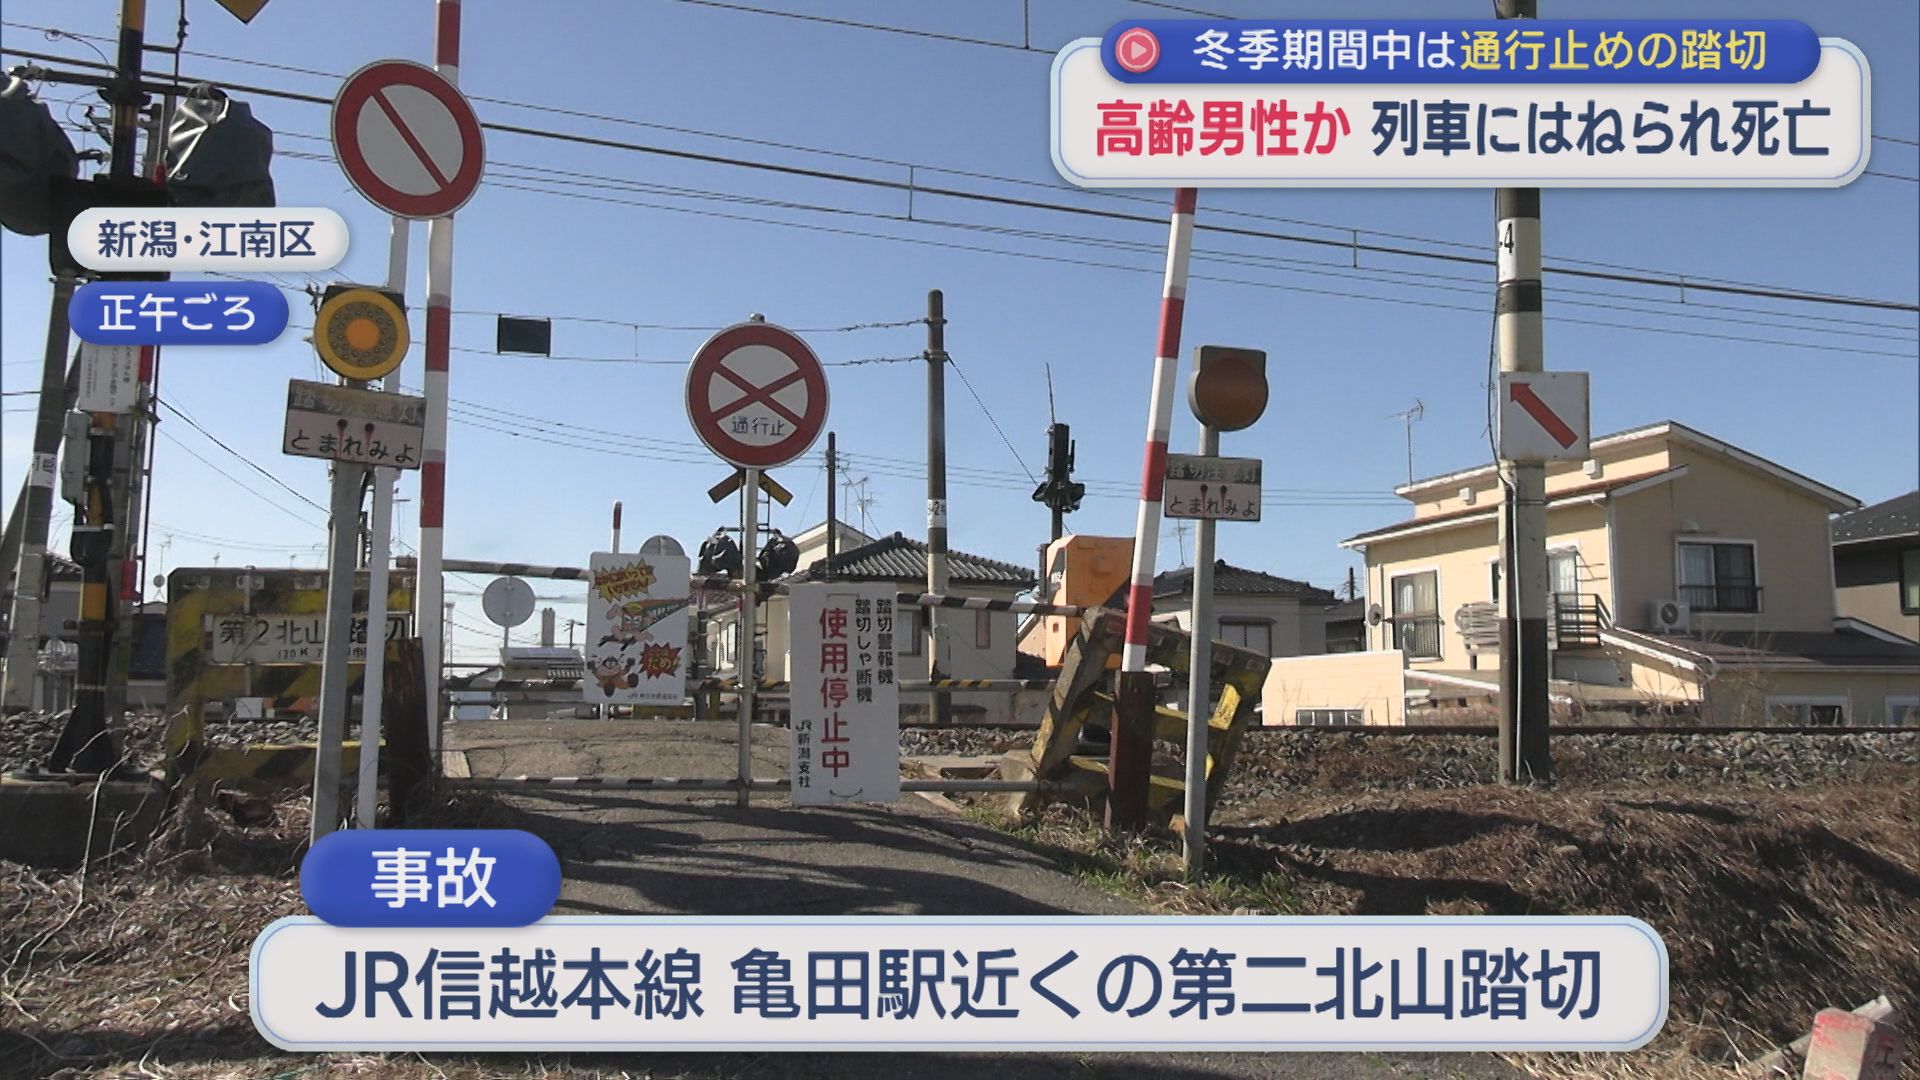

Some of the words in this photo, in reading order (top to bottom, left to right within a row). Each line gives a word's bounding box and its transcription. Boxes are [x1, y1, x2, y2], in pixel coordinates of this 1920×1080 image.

[730, 416, 785, 436] 通行止
[290, 429, 415, 464] とまれみよ
[1169, 496, 1256, 518] とまれみよ
[876, 599, 893, 684] 踏切警報機
[819, 607, 850, 778] 使用停止中
